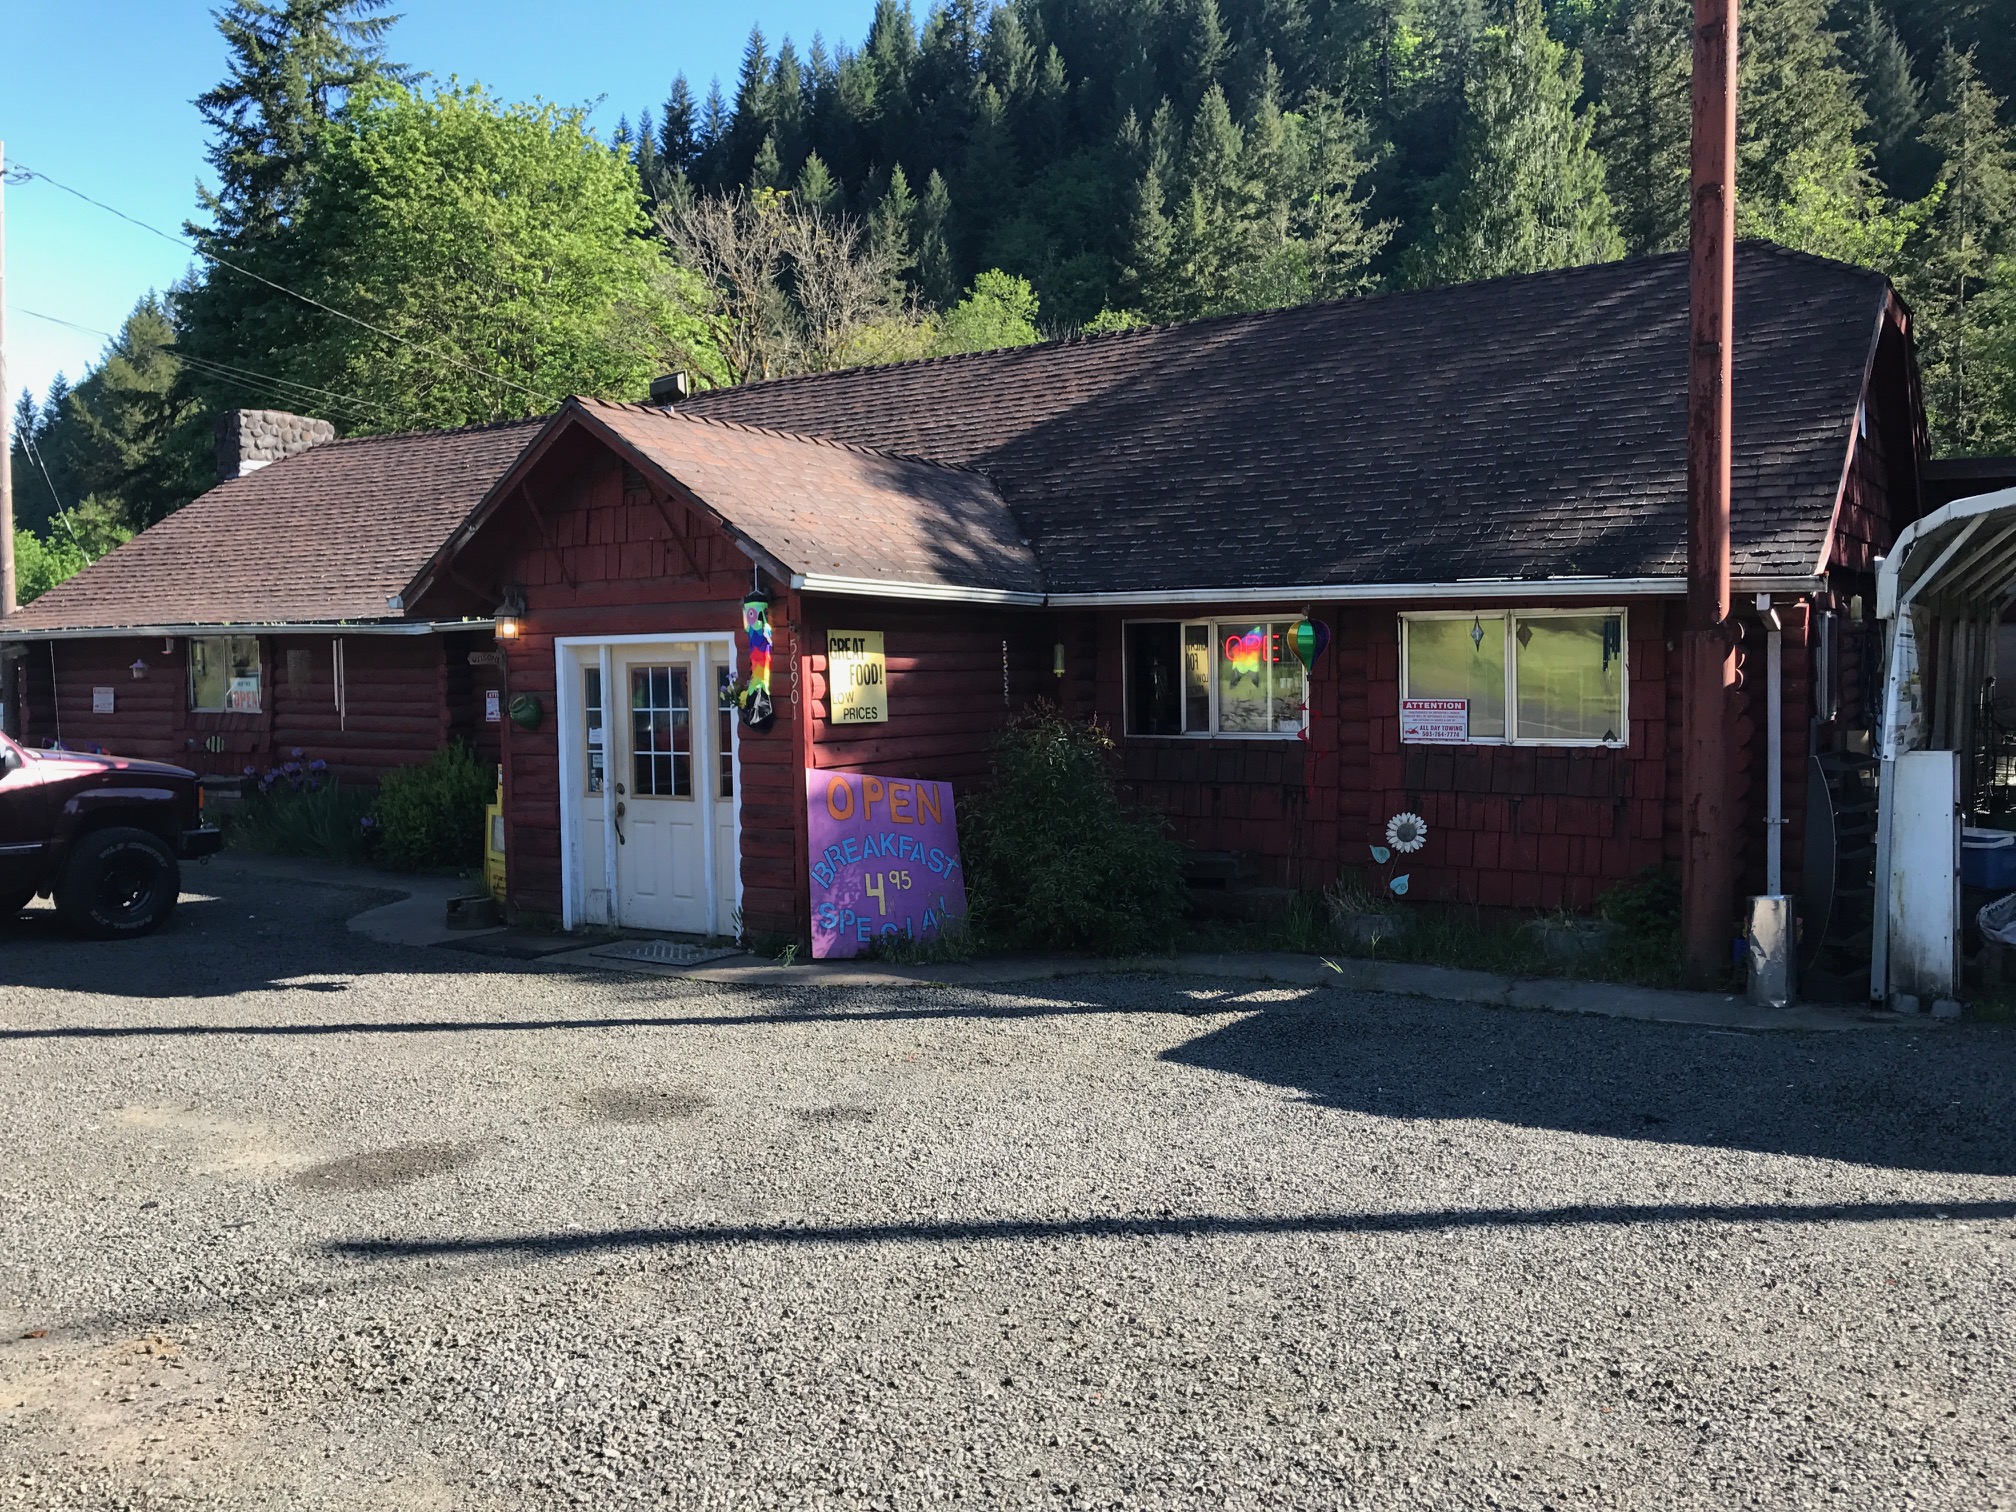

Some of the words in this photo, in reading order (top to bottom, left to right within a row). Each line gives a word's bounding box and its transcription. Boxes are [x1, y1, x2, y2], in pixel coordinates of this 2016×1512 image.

[829, 637, 865, 661] GREAT
[789, 639, 799, 721] 56901
[849, 663, 883, 686] FOOD!
[232, 690, 259, 710] OPEN
[832, 691, 855, 705] LOW
[843, 706, 878, 720] PRICES
[826, 775, 943, 825] OPEN
[810, 832, 960, 889] BREAKFAST
[818, 895, 956, 945] SPECIAL
